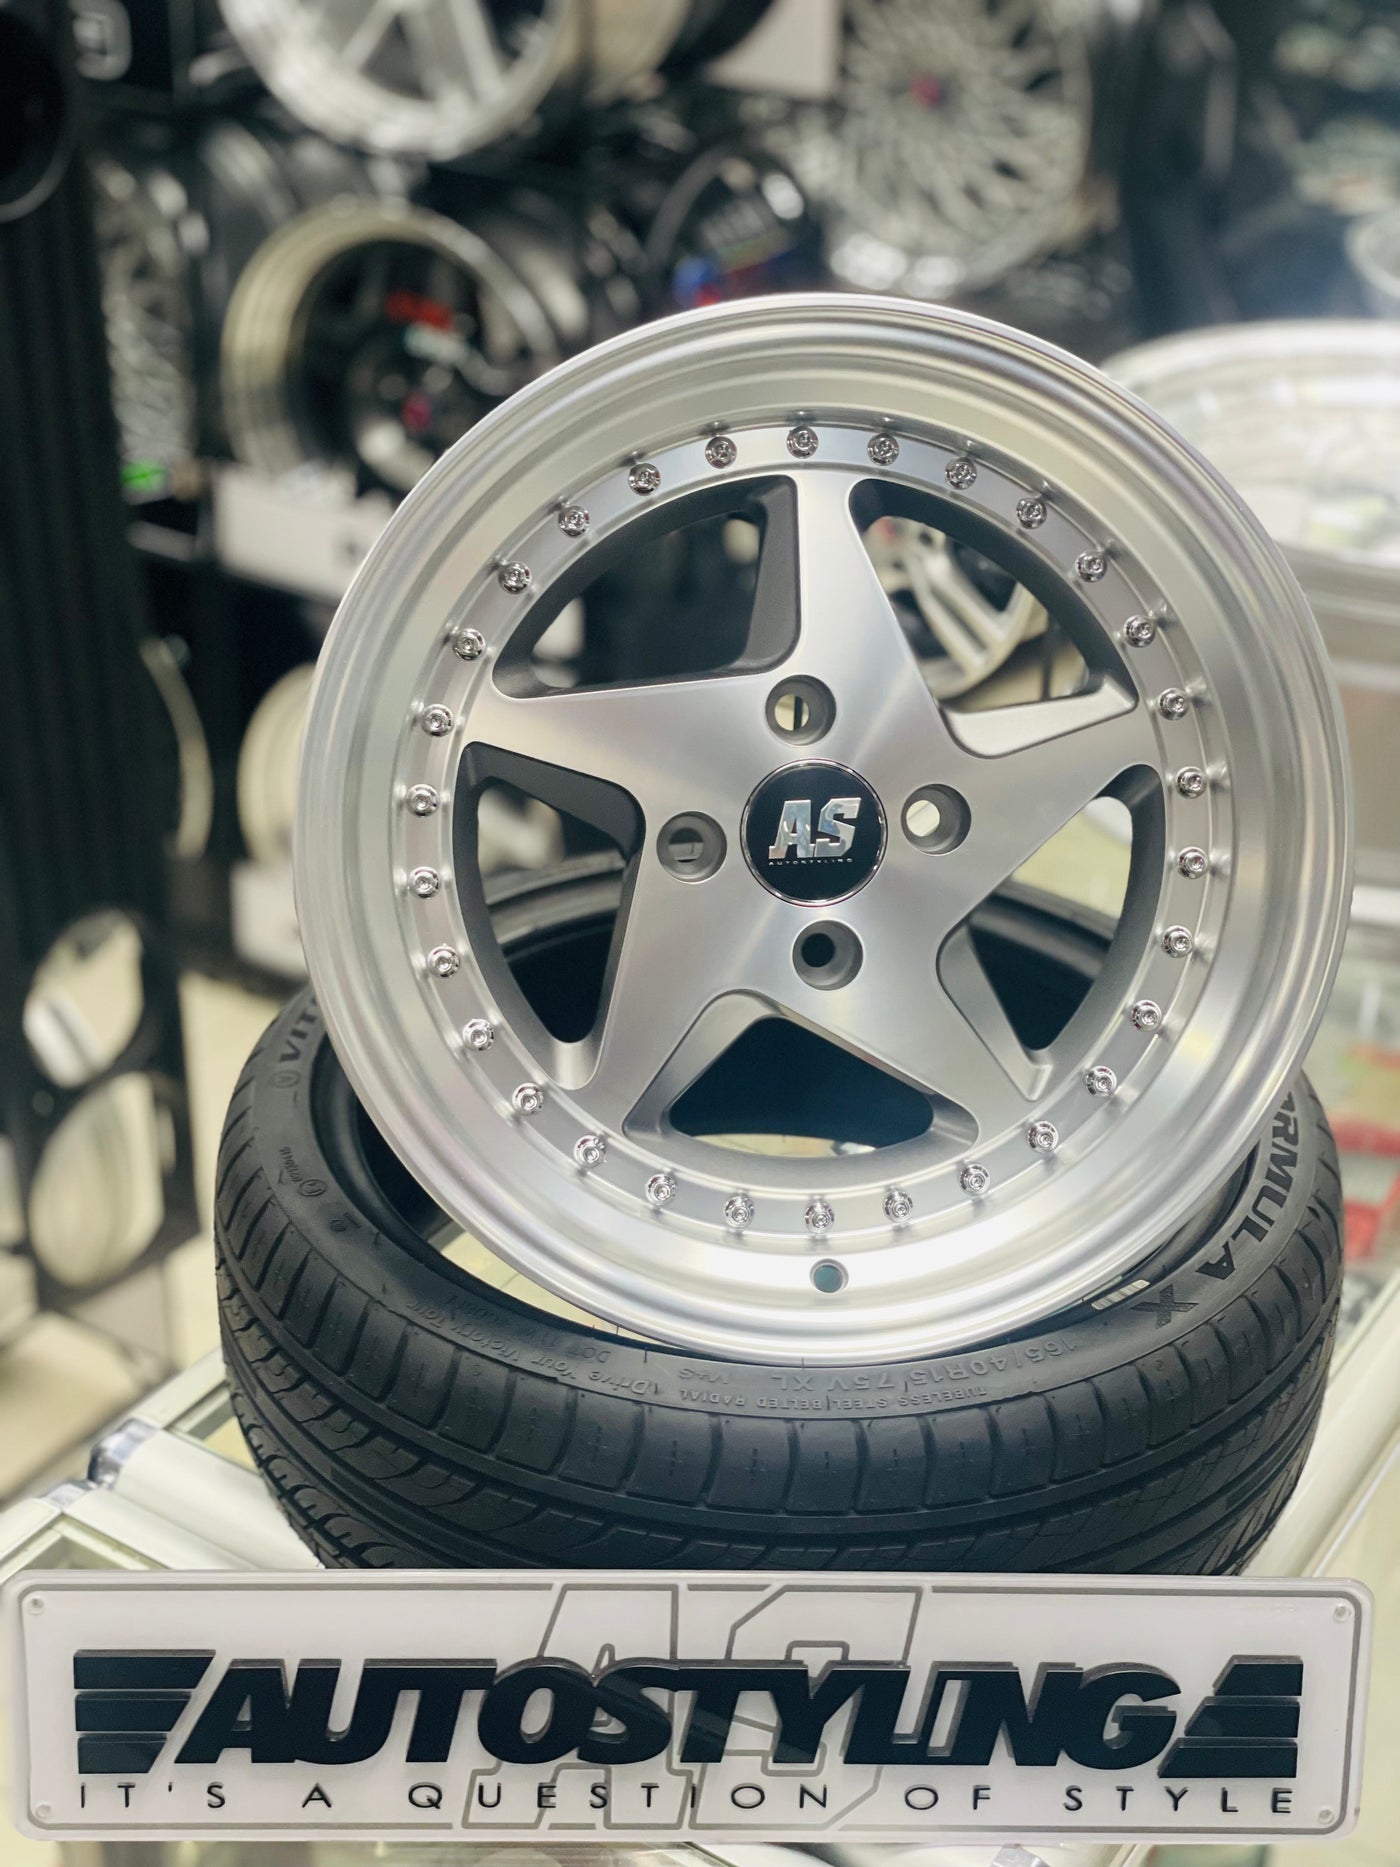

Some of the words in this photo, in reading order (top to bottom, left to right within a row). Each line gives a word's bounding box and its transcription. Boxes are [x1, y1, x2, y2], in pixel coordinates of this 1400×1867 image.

[768, 797, 861, 859] AS
[1130, 1284, 1199, 1329] X
[452, 1323, 519, 1362] Victory
[531, 1354, 576, 1379] Your
[588, 1370, 649, 1394] Drive
[771, 1374, 814, 1391] XL
[827, 1372, 895, 1392] 75V
[681, 1388, 746, 1407] RADIAL
[757, 1397, 823, 1411] BELTED
[831, 1397, 888, 1410] STEEL
[899, 1385, 988, 1408] TUBELESS
[174, 1657, 1182, 1770] AUTOSTYLING
[79, 1782, 226, 1809] IT'S
[301, 1782, 333, 1809] A
[406, 1782, 828, 1811] QUESTION
[904, 1784, 991, 1811] OF
[1063, 1786, 1293, 1814] STYLE
